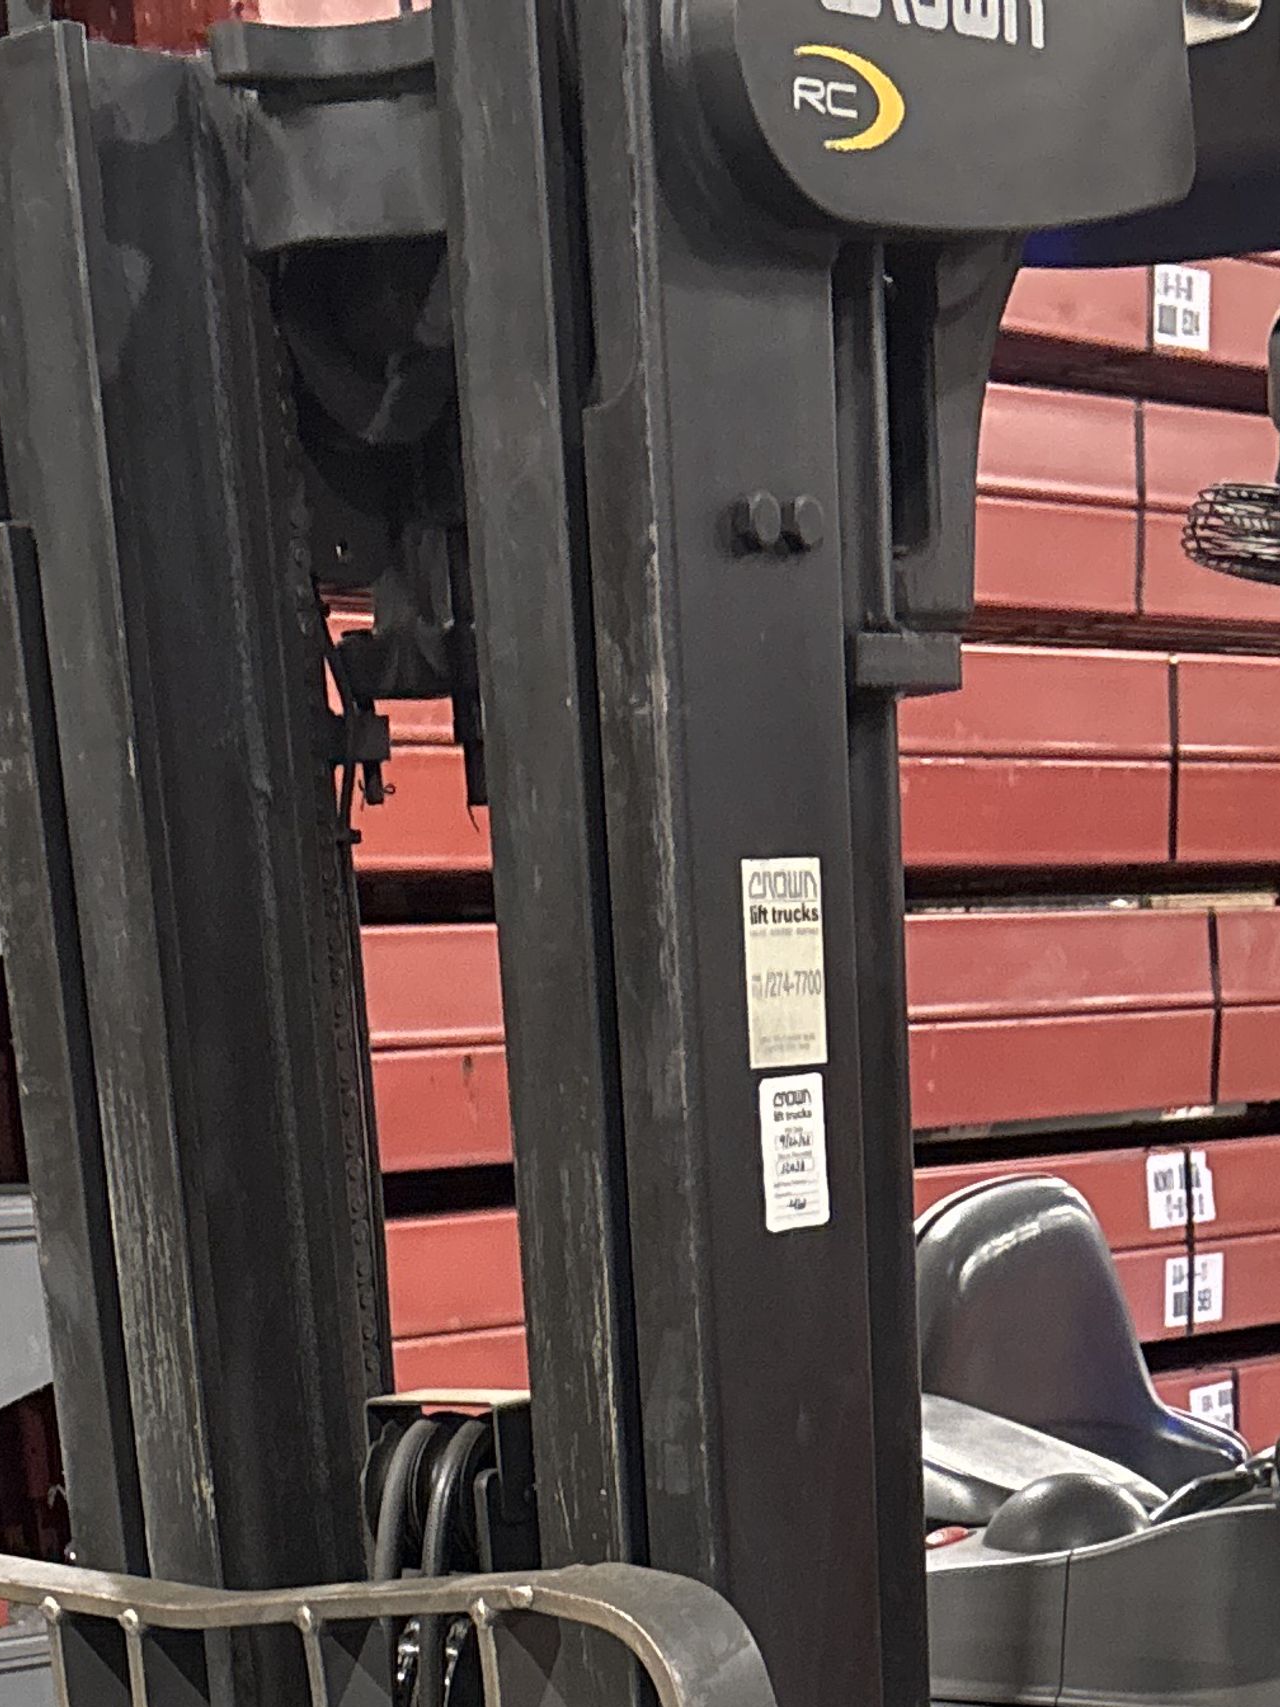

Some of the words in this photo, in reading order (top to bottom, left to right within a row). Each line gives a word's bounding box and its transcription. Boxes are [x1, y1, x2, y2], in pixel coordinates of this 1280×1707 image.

[793, 76, 858, 119] RC
[748, 870, 818, 899] CROWN
[750, 904, 769, 925] lift
[772, 902, 819, 924] trucks
